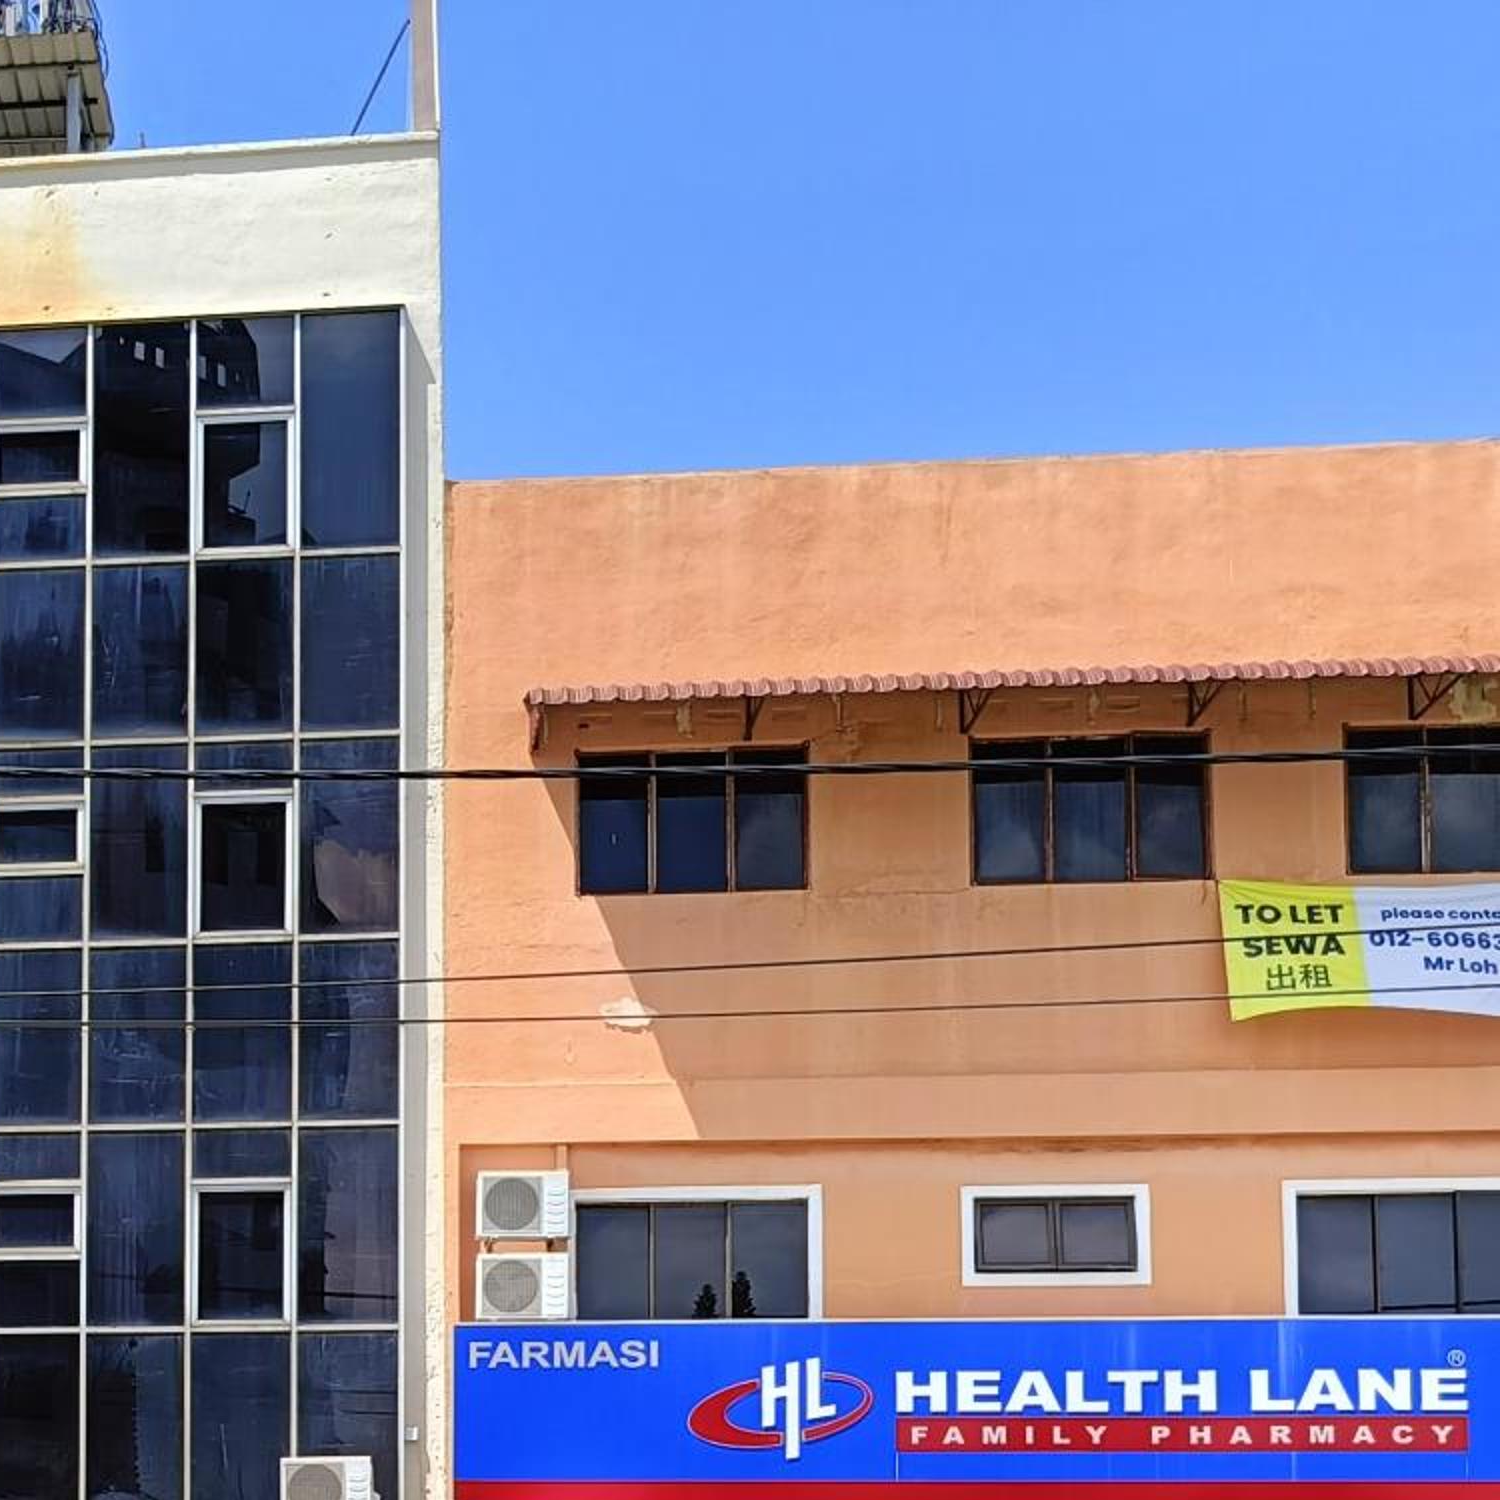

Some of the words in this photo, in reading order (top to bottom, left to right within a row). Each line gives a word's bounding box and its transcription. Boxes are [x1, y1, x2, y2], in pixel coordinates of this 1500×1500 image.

[1234, 904, 1282, 925] TO
[1289, 903, 1343, 925] LET
[1380, 907, 1445, 922] please
[1242, 932, 1345, 957] SEWA
[1266, 963, 1333, 991] 出租
[1423, 956, 1455, 971] Mr
[1459, 957, 1499, 975] Loh
[467, 1339, 660, 1368] FARMASI
[896, 1370, 1218, 1413] HEALTH
[1249, 1368, 1469, 1412] LANE
[760, 1356, 838, 1461] HL
[911, 1425, 1109, 1445] FAMILY
[1151, 1424, 1454, 1445] PHARMACY
